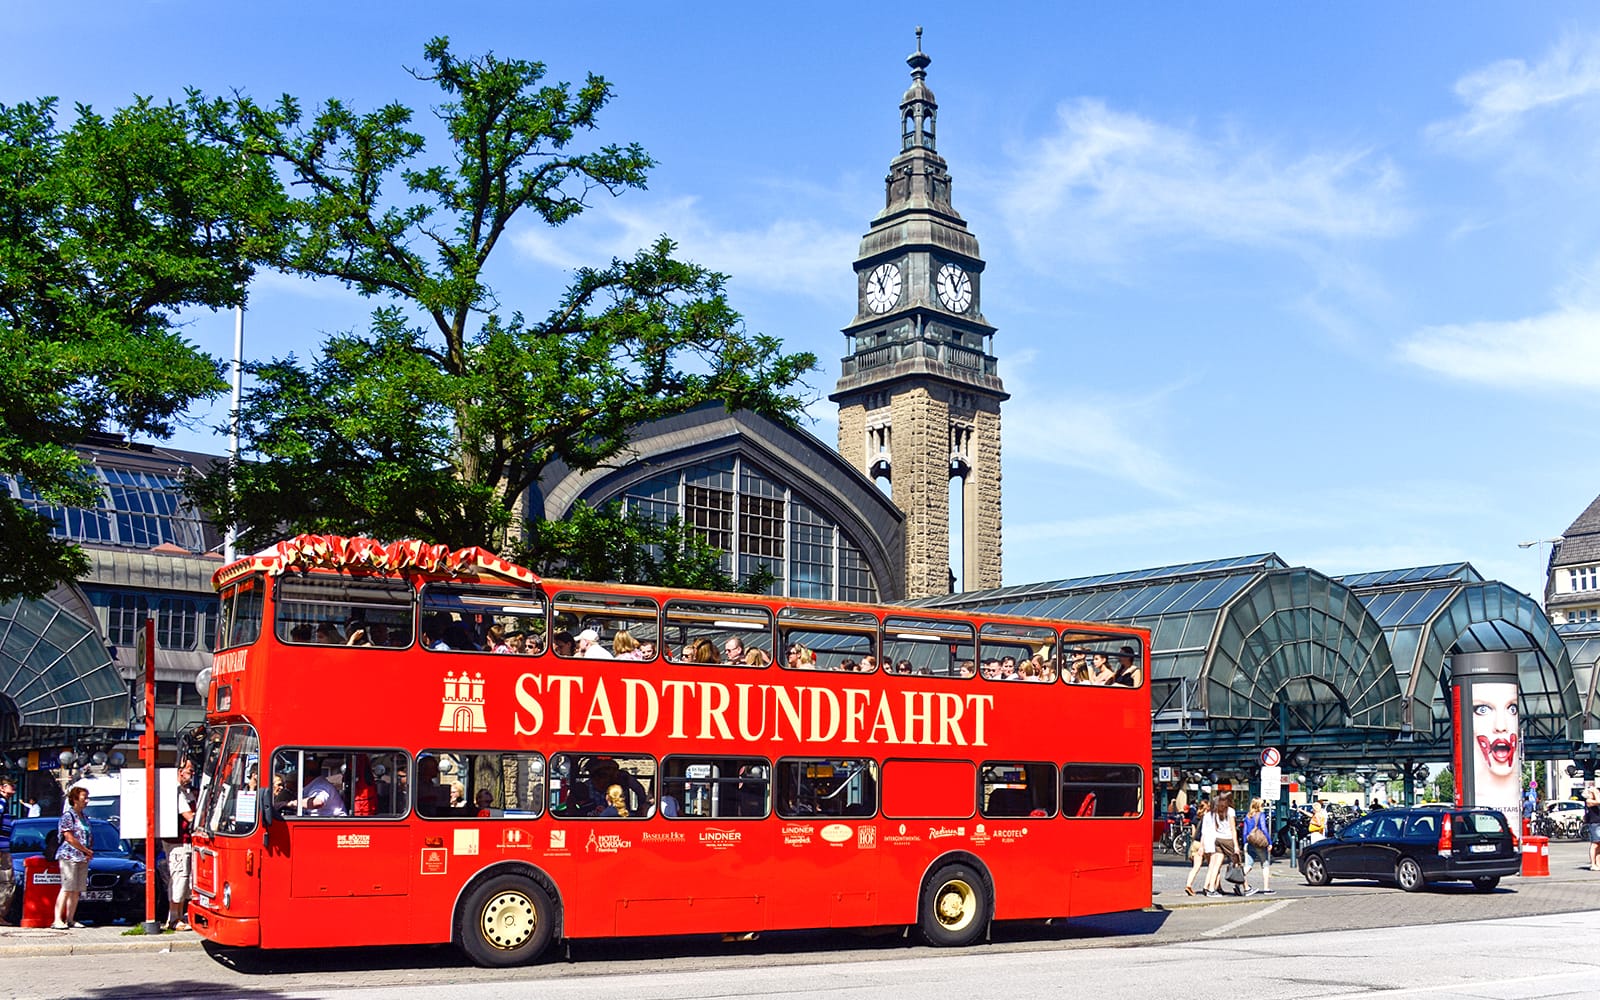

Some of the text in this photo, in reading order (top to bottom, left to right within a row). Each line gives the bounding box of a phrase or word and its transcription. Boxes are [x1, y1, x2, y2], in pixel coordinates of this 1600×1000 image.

[514, 672, 994, 747] STADTRUNDFAHRT
[598, 834, 621, 842] HOTEL
[699, 832, 742, 841] LINDNER
[993, 830, 1023, 838] ARCOTEL
[599, 840, 632, 848] VORBACH
